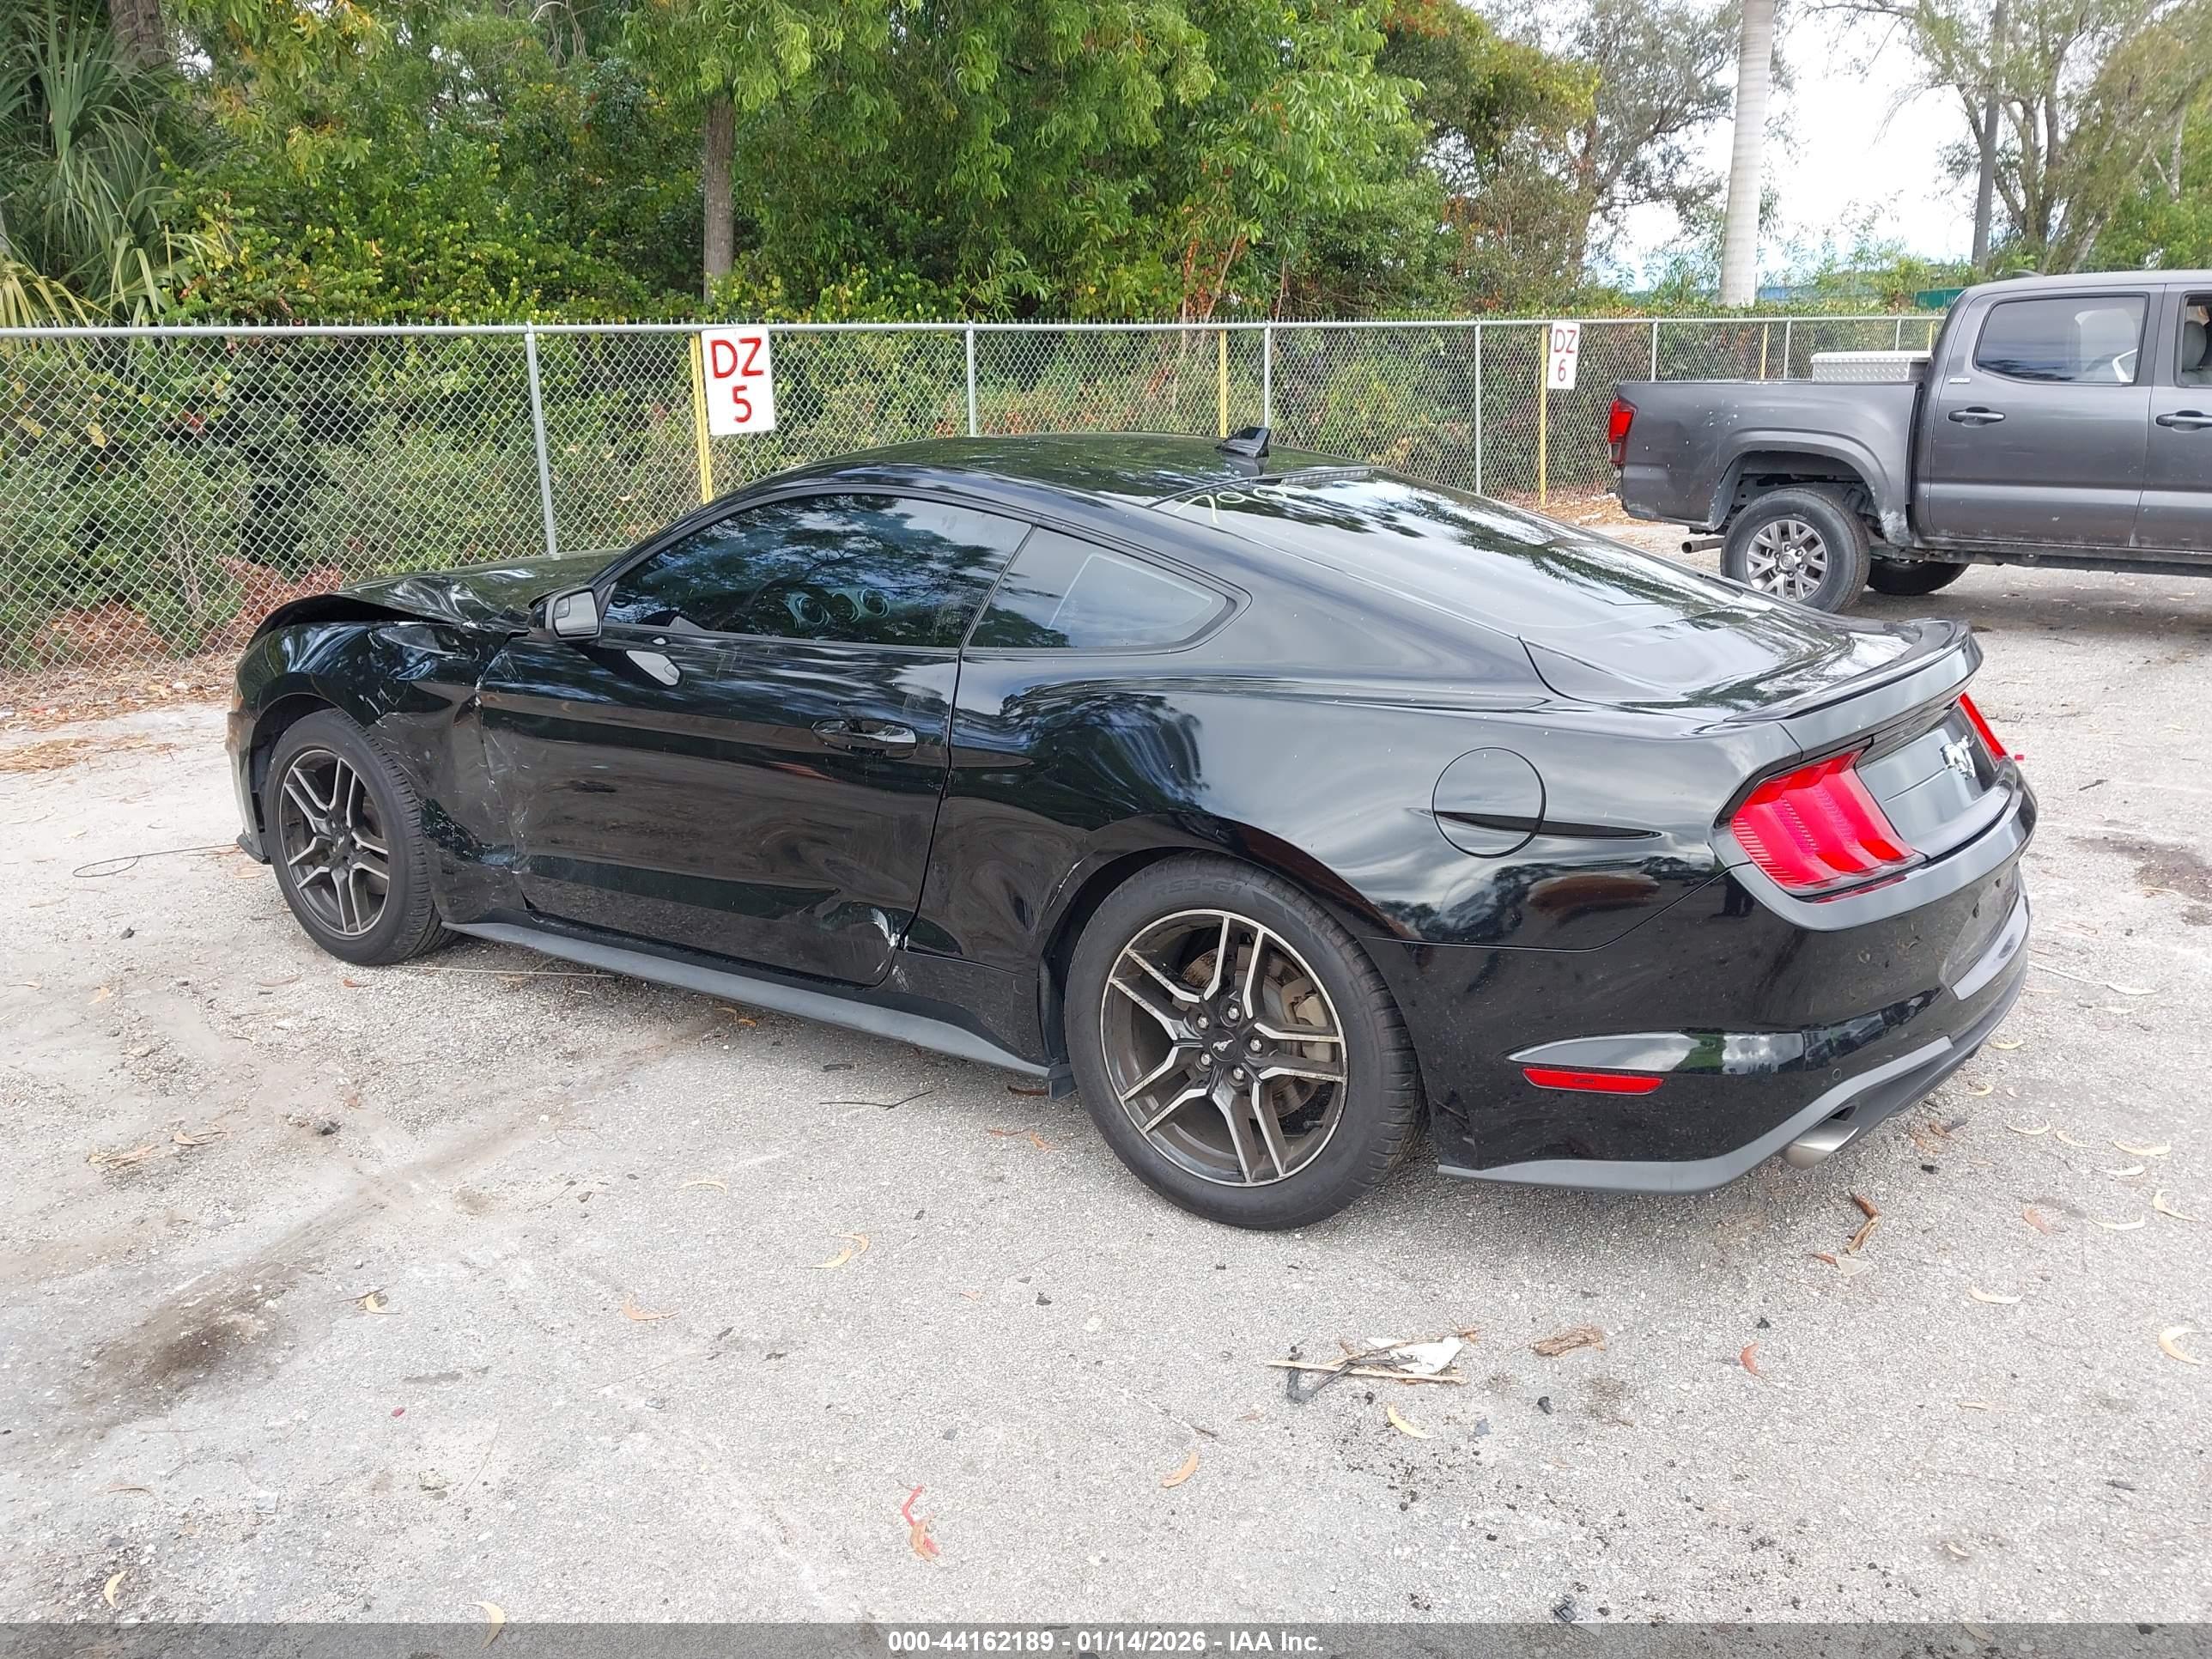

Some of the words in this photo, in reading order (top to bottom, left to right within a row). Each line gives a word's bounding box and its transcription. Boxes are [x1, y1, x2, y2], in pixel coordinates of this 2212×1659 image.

[1553, 328, 1577, 354] DZ
[710, 337, 764, 379] DZ
[1558, 358, 1567, 381] 6
[732, 385, 752, 423] 5
